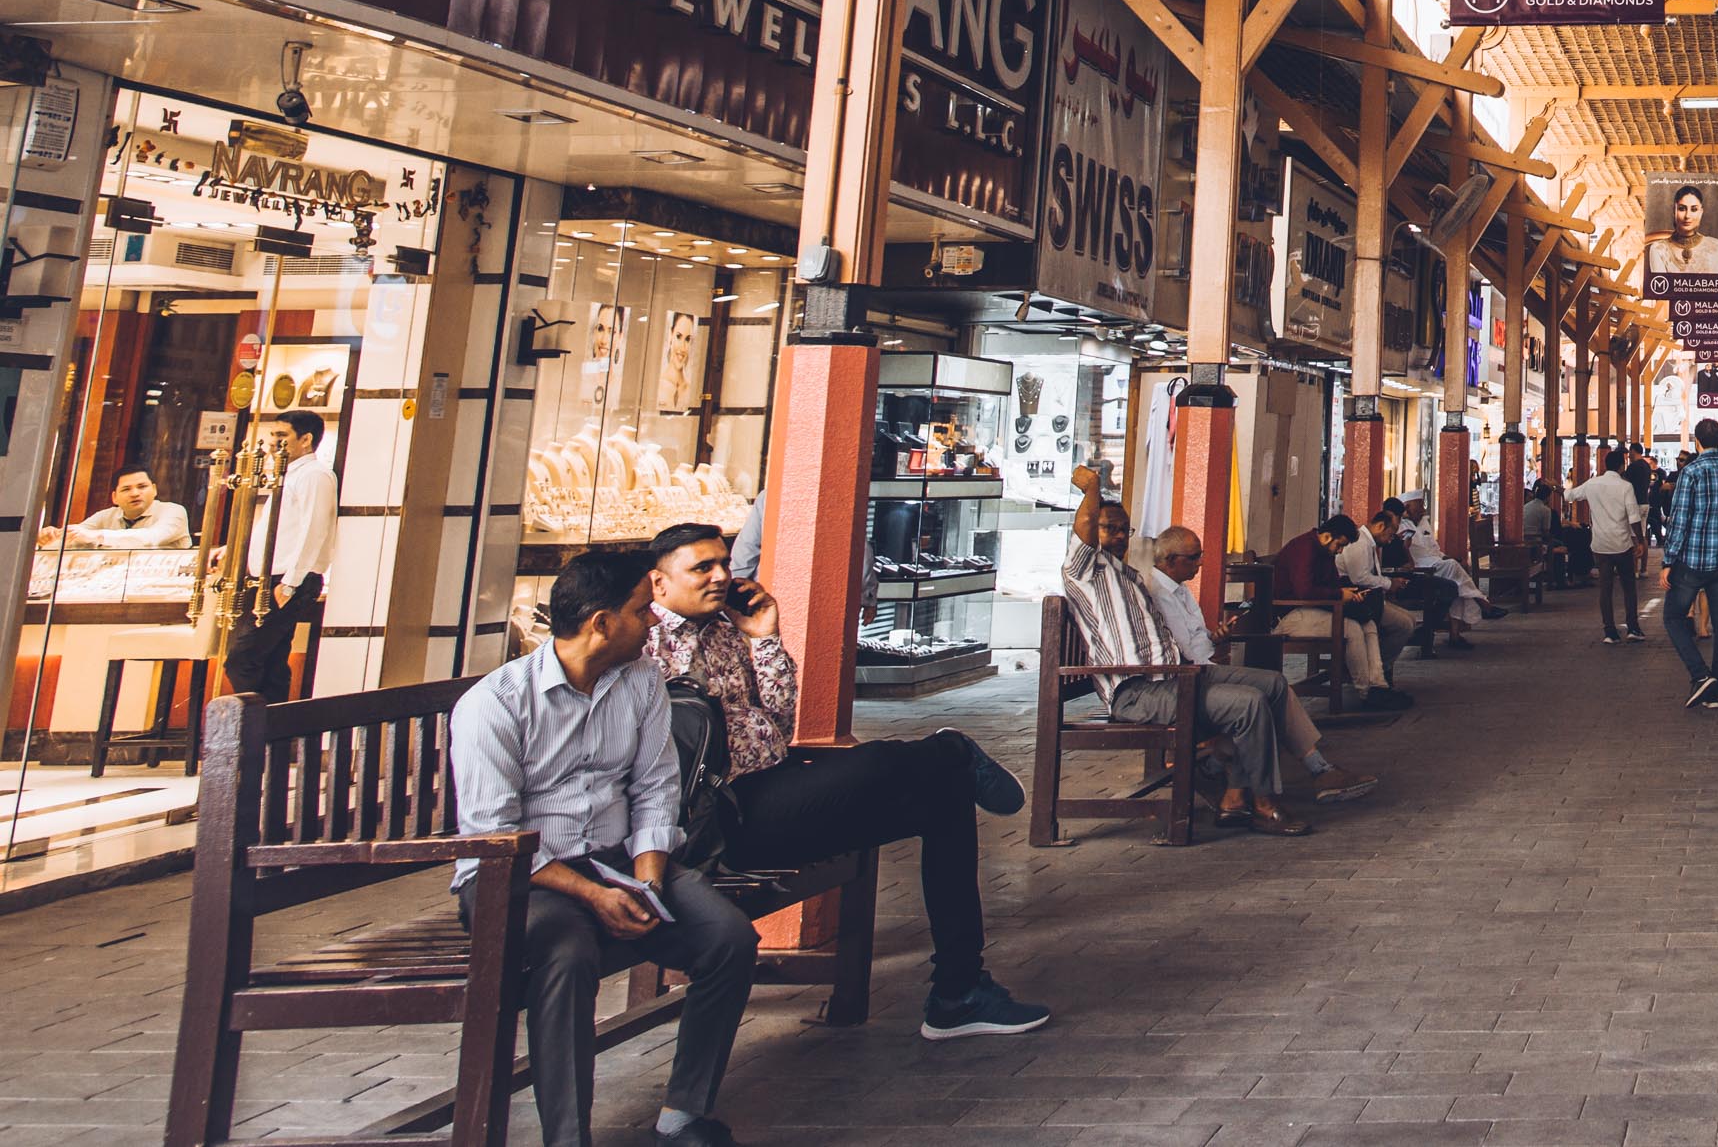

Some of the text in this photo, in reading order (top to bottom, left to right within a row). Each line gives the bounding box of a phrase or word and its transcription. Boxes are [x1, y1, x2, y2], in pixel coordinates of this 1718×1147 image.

[208, 189, 316, 217] JEWLLERS
[211, 140, 375, 204] NAVRANG
[1049, 142, 1154, 278] SWISS
